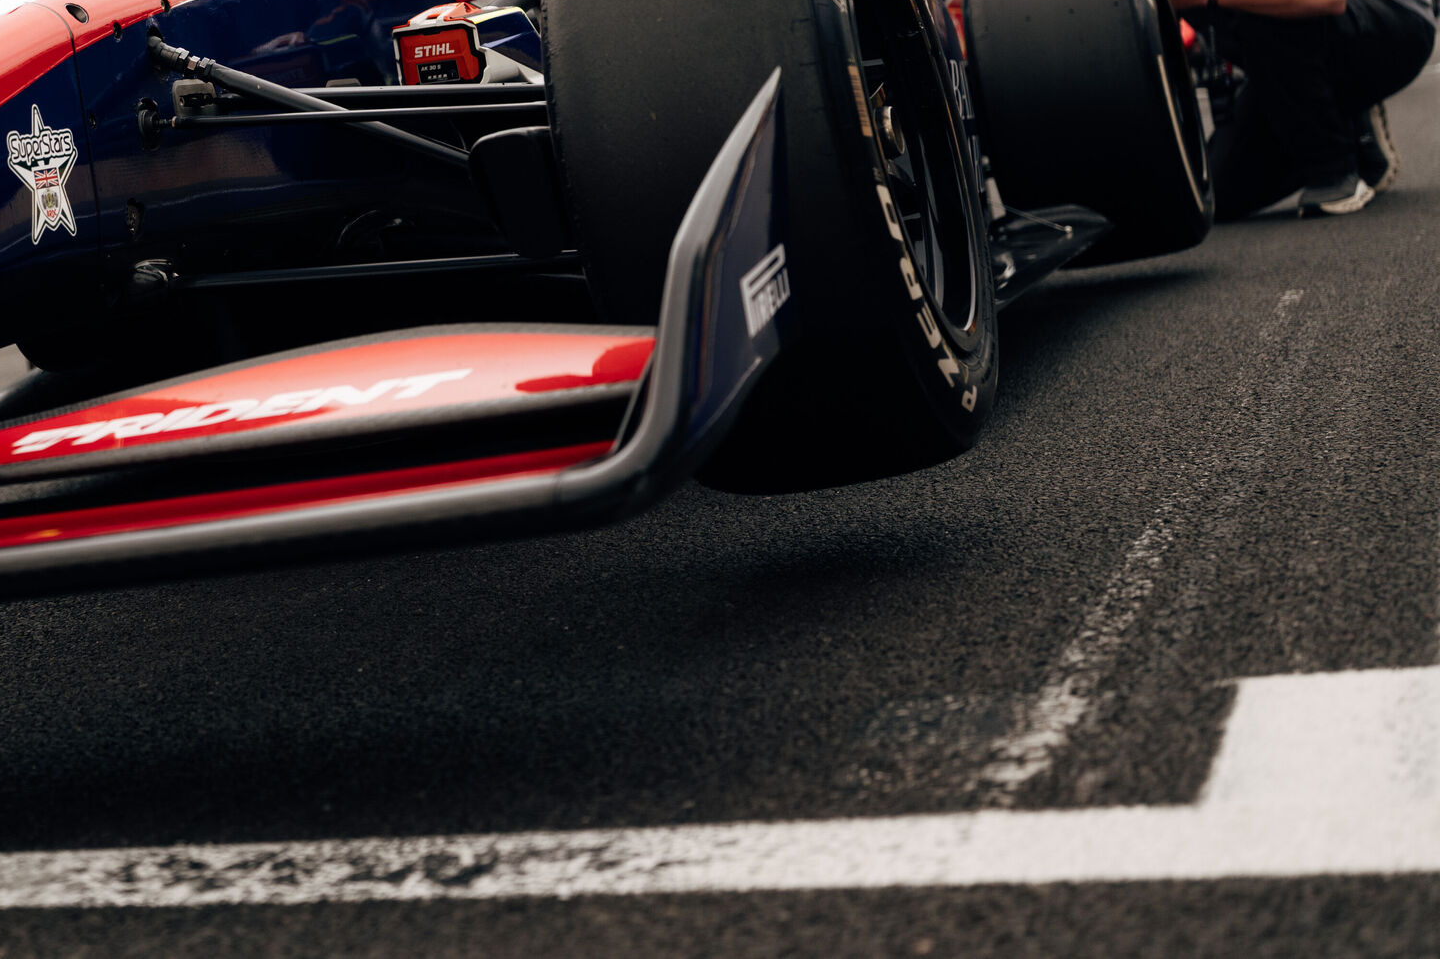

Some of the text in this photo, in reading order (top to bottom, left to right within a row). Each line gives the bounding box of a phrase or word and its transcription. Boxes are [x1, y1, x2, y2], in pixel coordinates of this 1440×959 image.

[414, 42, 455, 59] STIHL
[9, 132, 73, 163] SuperStars
[739, 242, 791, 338] PIRELLI
[11, 367, 474, 456] TRIDENT
